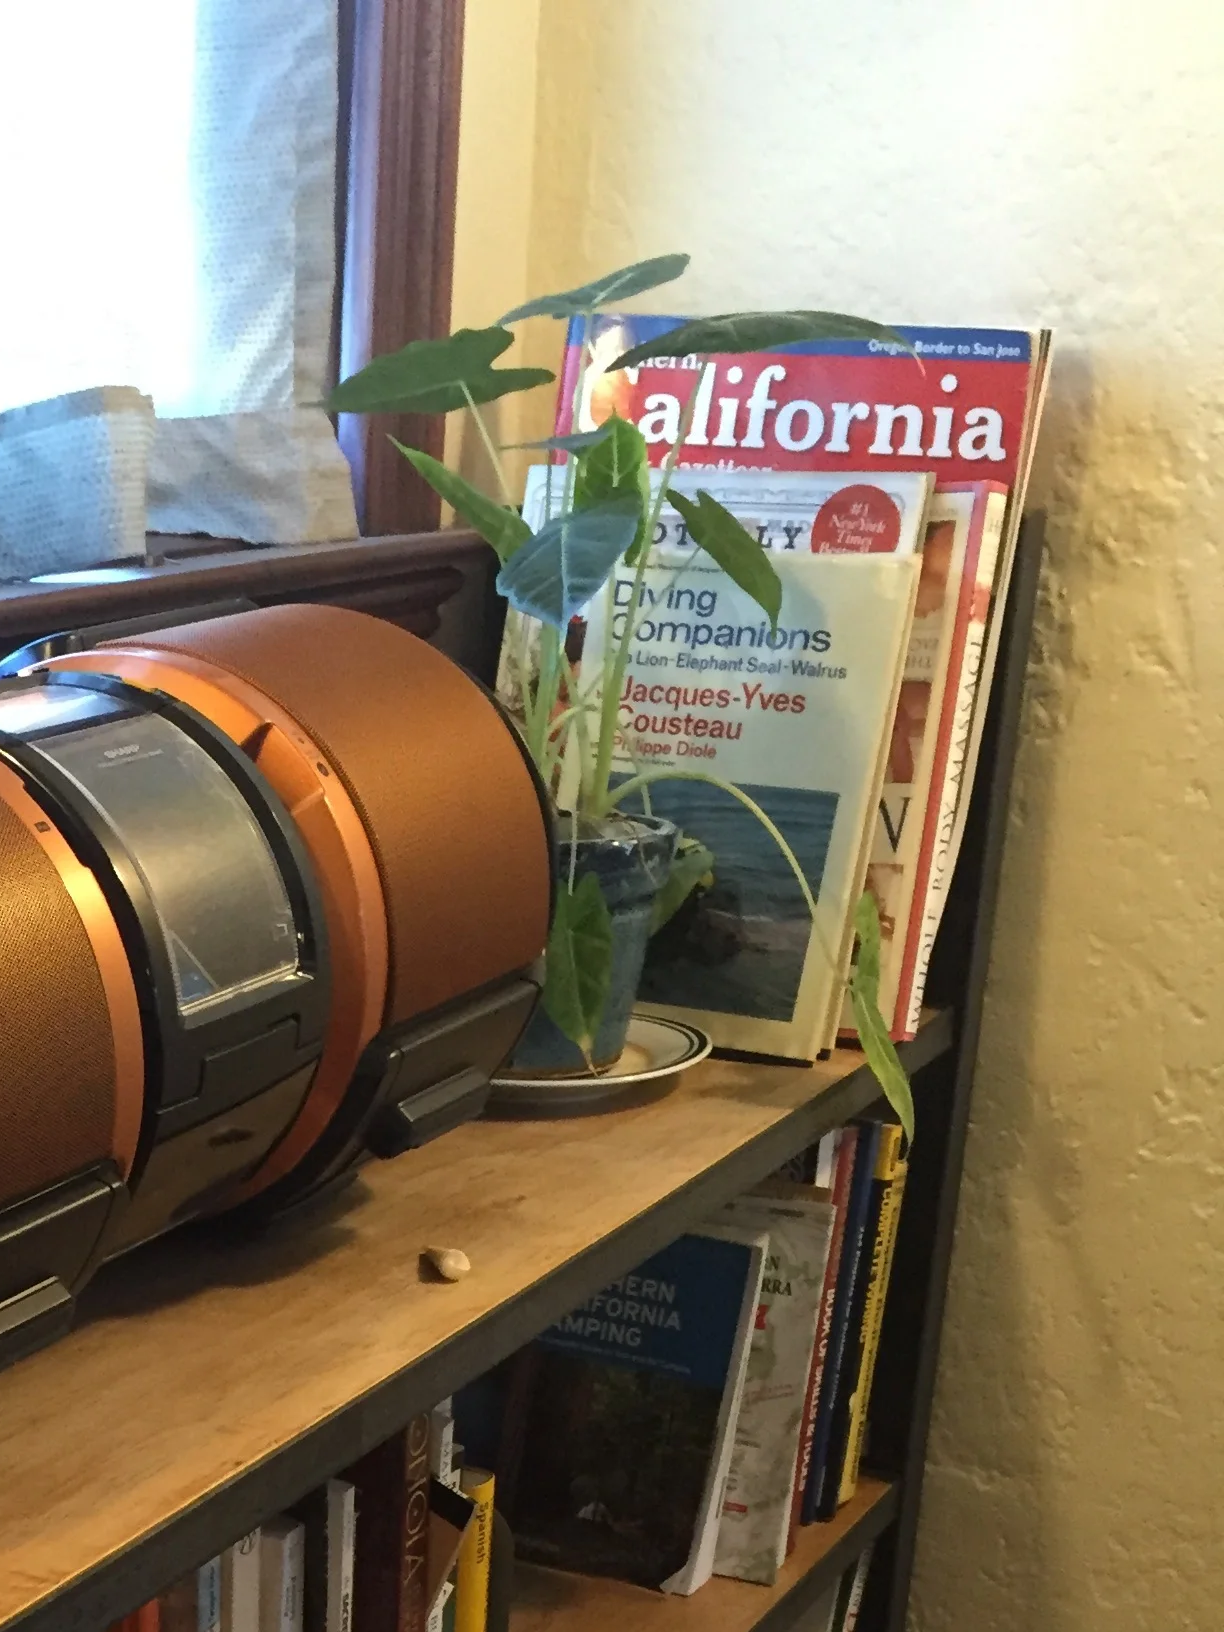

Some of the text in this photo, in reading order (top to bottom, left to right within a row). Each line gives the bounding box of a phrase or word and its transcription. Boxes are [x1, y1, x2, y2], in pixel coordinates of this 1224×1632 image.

[914, 340, 955, 354] Border
[957, 344, 970, 355] to
[973, 342, 995, 356] San
[996, 343, 1021, 358] Jose
[611, 612, 832, 654] Companions
[636, 650, 744, 673] Lion-Elephant
[620, 674, 807, 714] Jacques-Yves
[618, 703, 743, 741] Cousteau
[553, 1313, 643, 1349] AMPING
[472, 1501, 490, 1564] Spanish
